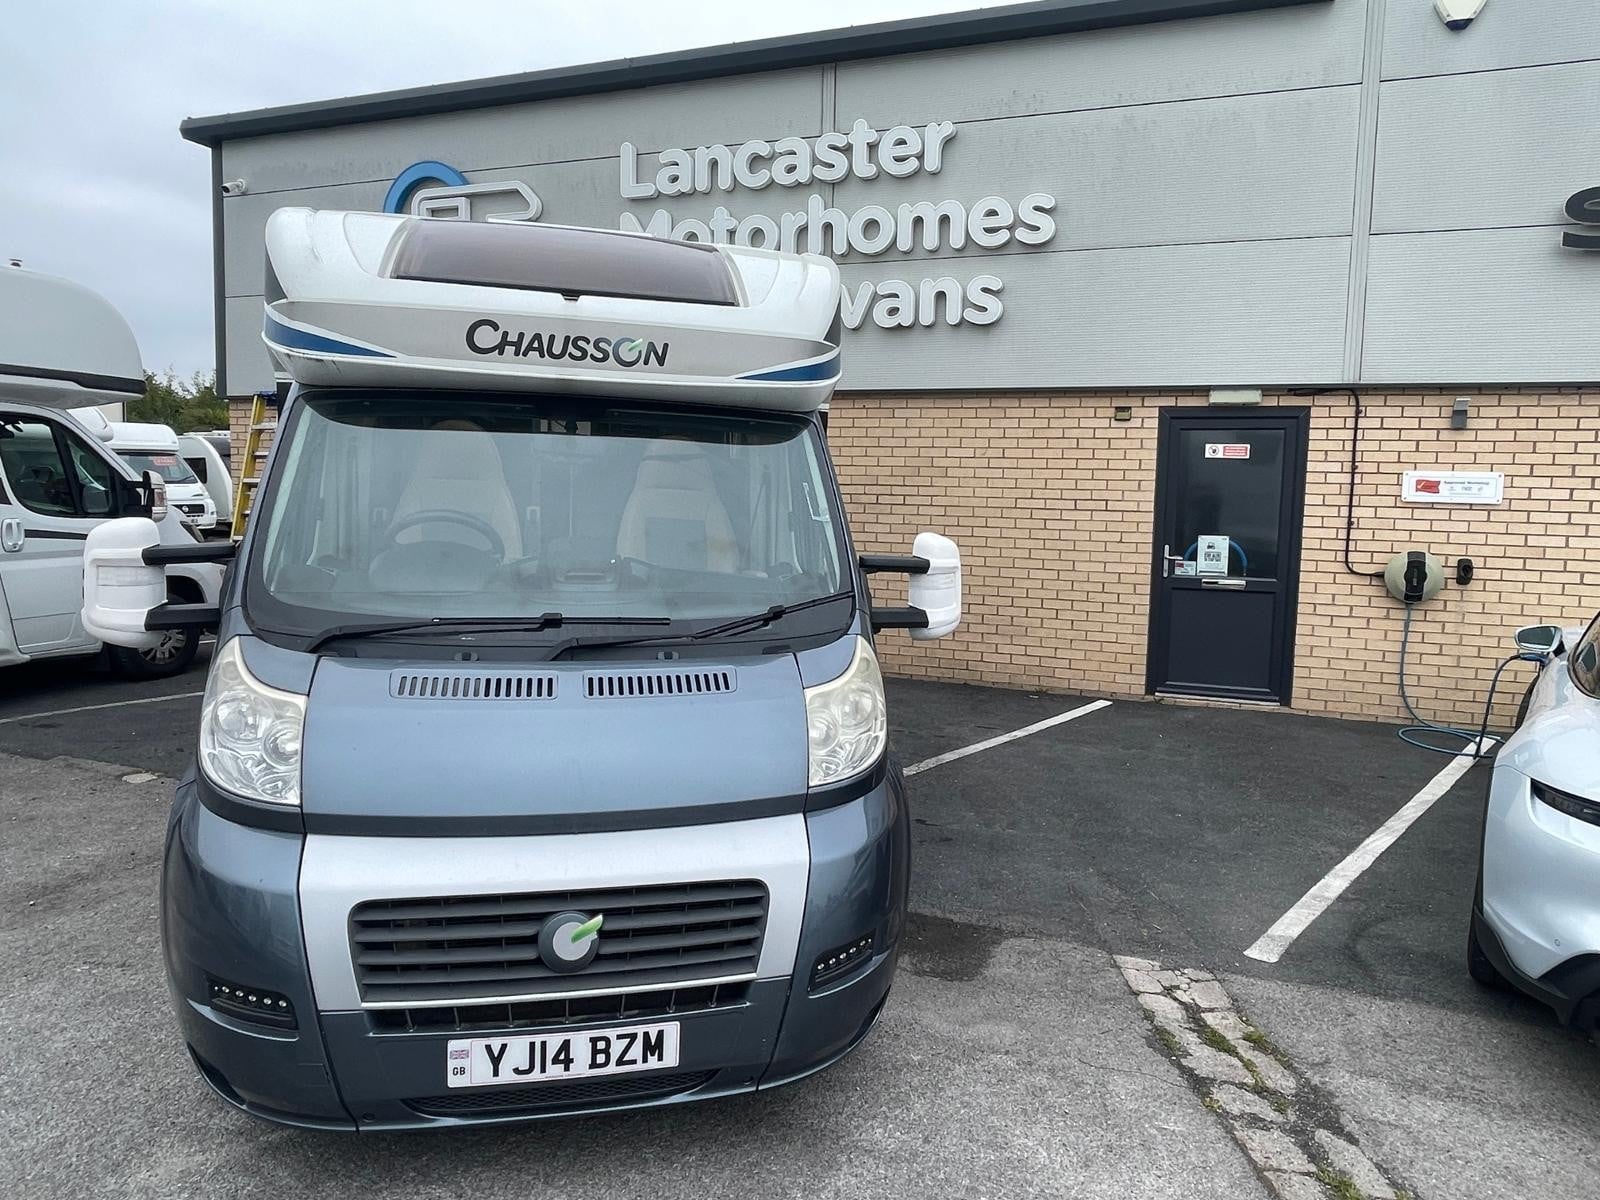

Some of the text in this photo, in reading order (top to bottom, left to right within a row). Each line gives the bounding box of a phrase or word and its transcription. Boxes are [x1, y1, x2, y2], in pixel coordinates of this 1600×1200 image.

[619, 118, 957, 199] Lancaster
[465, 318, 670, 368] CHAUSSON
[452, 1066, 466, 1076] GB
[484, 1029, 665, 1078] YJ14 BZM
